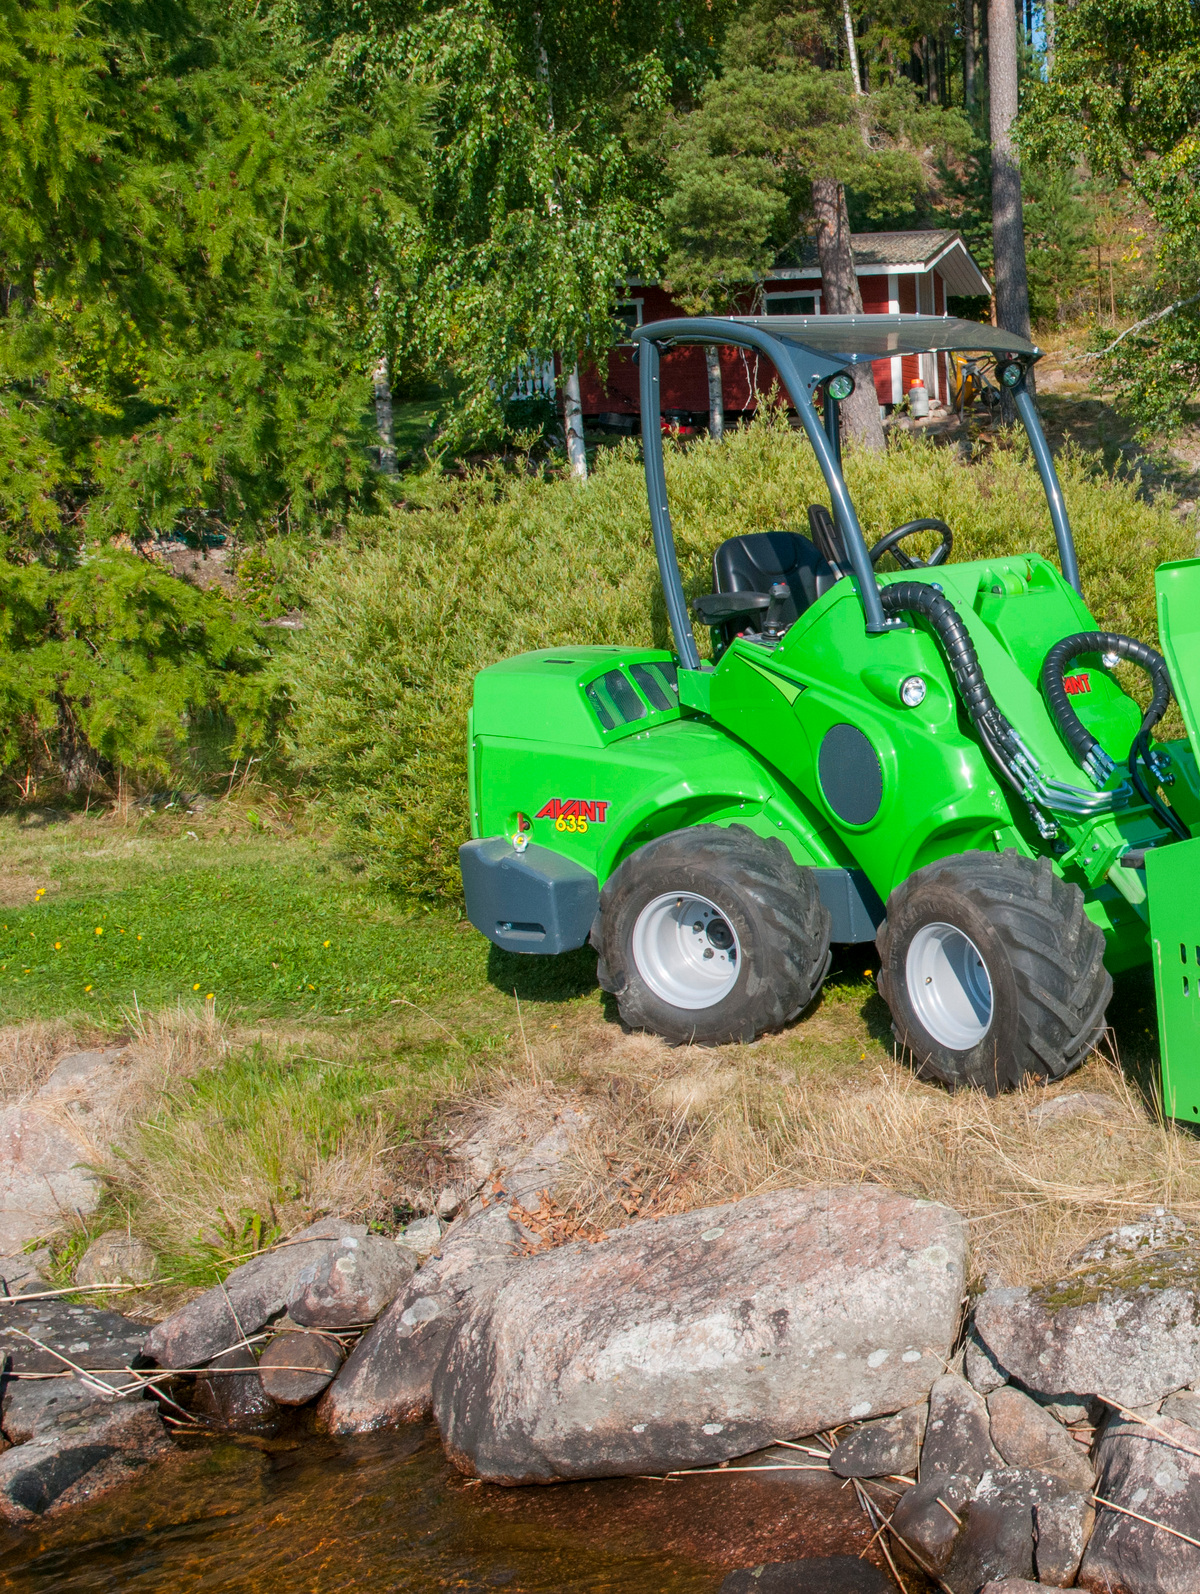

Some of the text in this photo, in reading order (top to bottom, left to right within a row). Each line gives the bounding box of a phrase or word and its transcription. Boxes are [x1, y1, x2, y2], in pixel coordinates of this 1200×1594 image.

[1063, 673, 1092, 695] ANT
[535, 798, 608, 823] AVANT
[555, 814, 588, 833] 635
